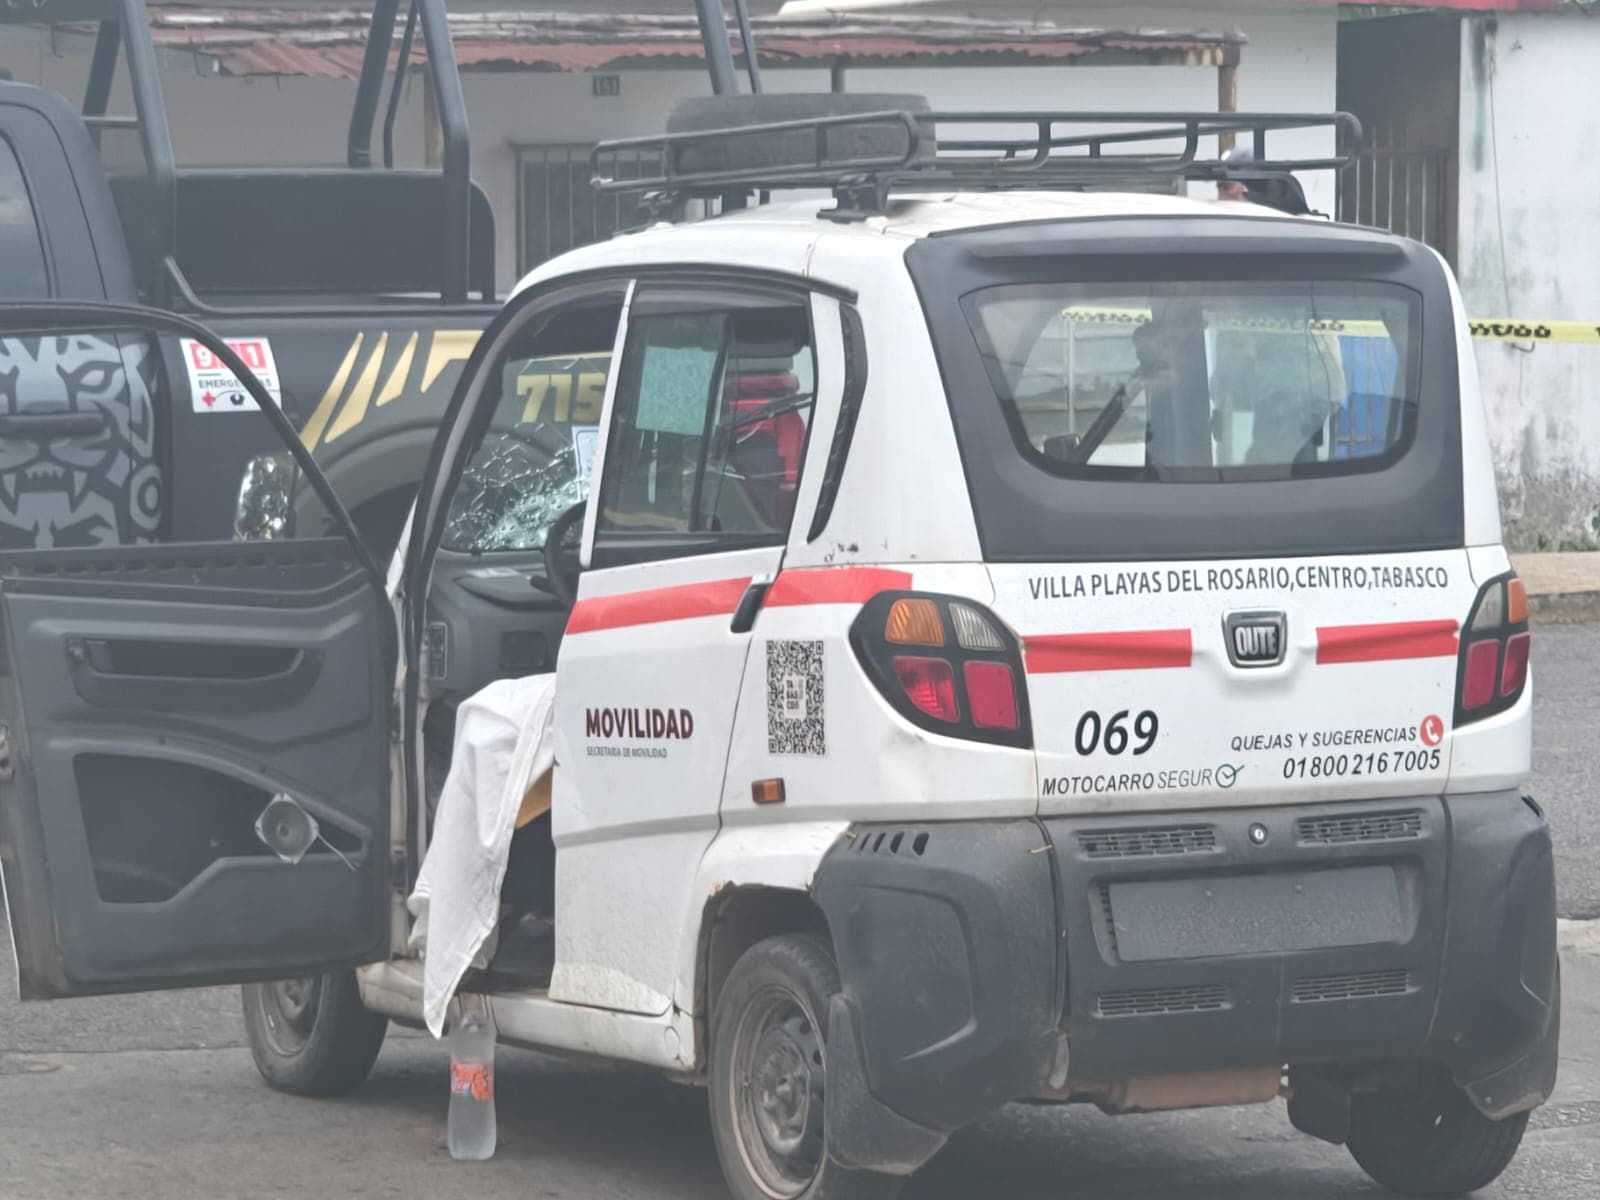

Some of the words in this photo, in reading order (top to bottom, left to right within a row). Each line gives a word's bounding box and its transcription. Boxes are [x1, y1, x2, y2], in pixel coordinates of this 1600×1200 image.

[196, 344, 260, 369] 91
[516, 372, 606, 422] 715
[1029, 575, 1086, 600] VILLA
[1091, 571, 1162, 596] PLAYAS
[1167, 569, 1203, 593] DEL
[586, 707, 694, 739] MOVILIDAD
[1074, 709, 1159, 756] 069
[623, 747, 630, 758] DE
[632, 748, 668, 758] MOVILIDAD
[1231, 733, 1293, 751] QUEJAS
[1298, 733, 1308, 747] Y
[1312, 726, 1417, 747] SUGERENCIAS
[1042, 774, 1154, 796] MOTOCARRO
